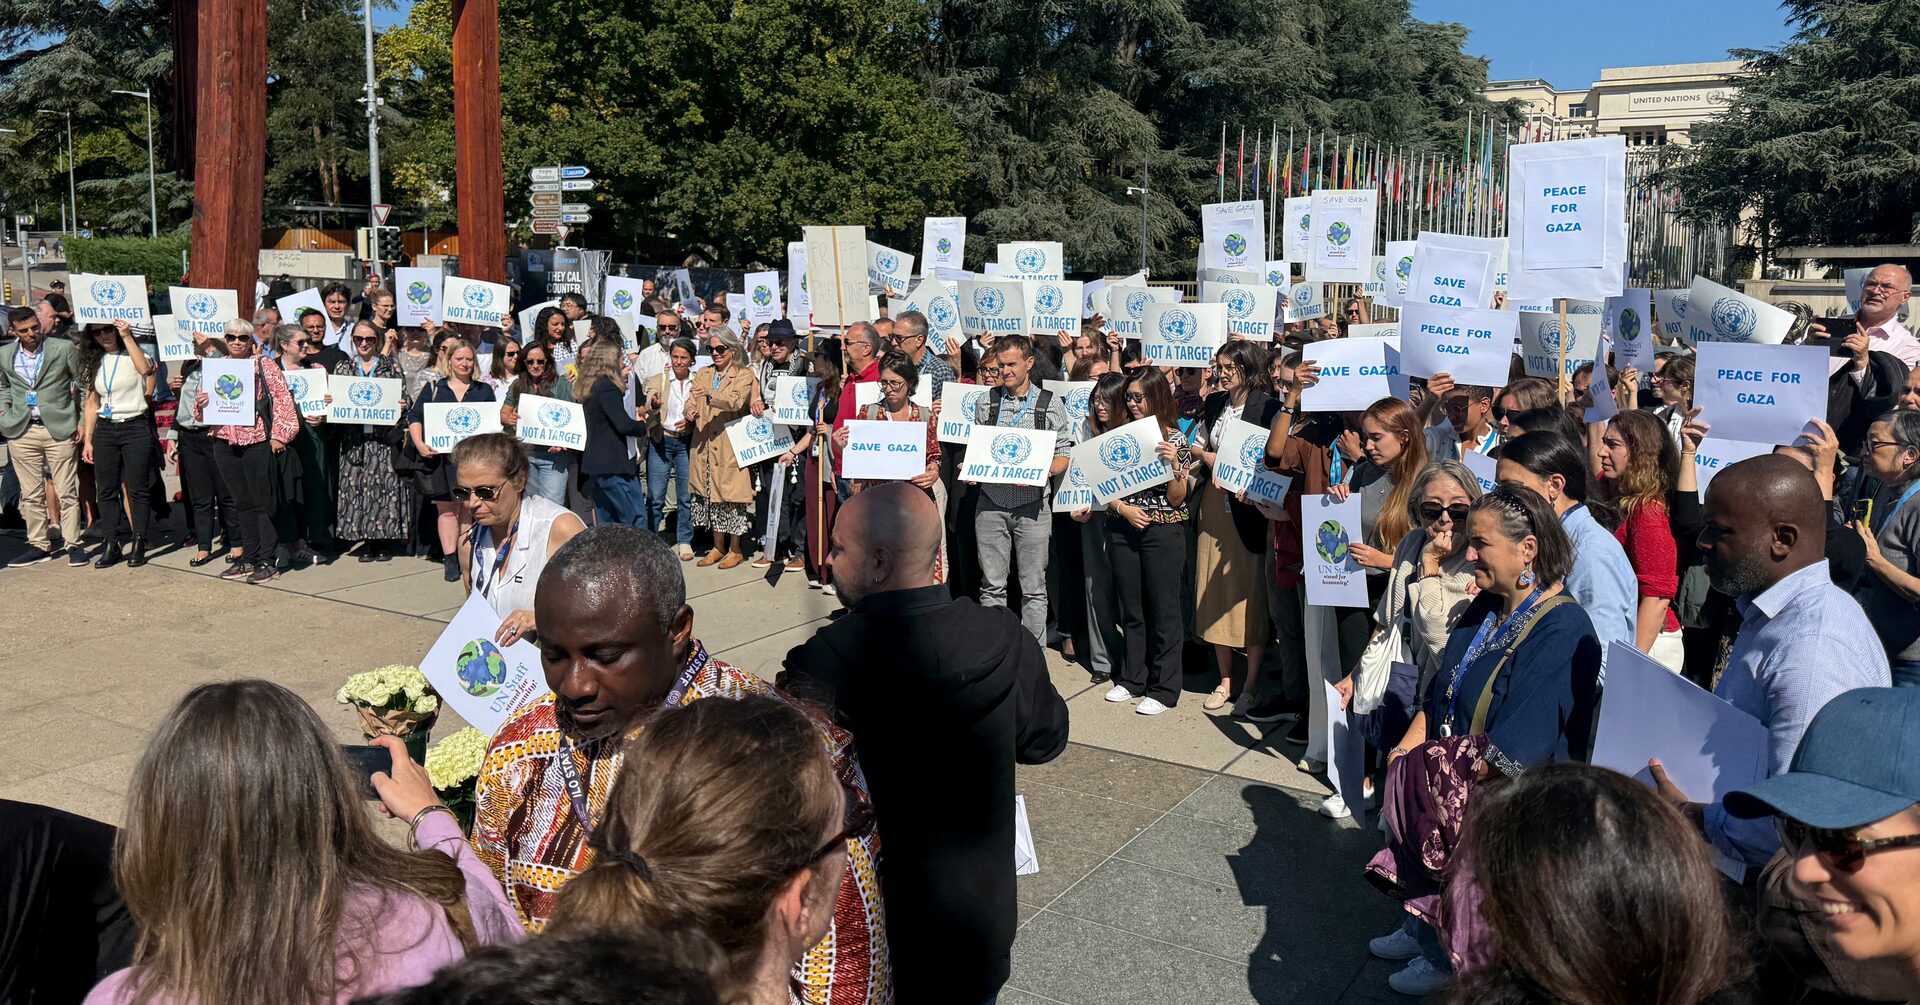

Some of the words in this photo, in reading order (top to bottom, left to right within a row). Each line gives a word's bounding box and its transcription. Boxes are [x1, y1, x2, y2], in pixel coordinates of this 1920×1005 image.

[1664, 94, 1700, 102] NATIONS
[1544, 186, 1586, 196] PEACE
[1323, 196, 1344, 204] SAVE
[1348, 196, 1368, 204] GAZA
[1216, 206, 1234, 215] SAVE
[1236, 204, 1256, 214] GAZA
[1551, 204, 1577, 213] FOR
[1546, 222, 1582, 233] GAZA
[547, 272, 566, 282] THEY
[567, 271, 581, 282] CAL
[1434, 276, 1466, 288] SAVE
[1365, 282, 1378, 292] NOT
[906, 302, 920, 312] NO
[1429, 295, 1462, 307] GAZA
[80, 307, 99, 318] NOT
[101, 309, 106, 319] A
[109, 308, 143, 320] TARGET
[448, 306, 464, 318] NOT
[466, 309, 472, 318] A
[1288, 308, 1300, 318] NOT
[1300, 307, 1305, 318] A
[1305, 304, 1321, 316] TARGET
[178, 320, 190, 332] NOT
[192, 322, 198, 332] A
[198, 322, 225, 333] TARG
[965, 316, 979, 330] NOT
[982, 318, 987, 330] A
[988, 316, 1021, 331] TARGET
[1037, 317, 1043, 330] A
[1044, 316, 1076, 331] TARGET
[1115, 320, 1130, 332] NOT
[1132, 321, 1137, 332] A
[1232, 320, 1268, 335] TARGET
[1664, 322, 1682, 333] NOT
[1421, 324, 1460, 336] PEACE
[1467, 329, 1492, 339] FOR
[1690, 326, 1712, 342] NOT
[165, 345, 183, 355] NOT
[184, 344, 190, 354] A
[1145, 345, 1164, 359] NOT
[1166, 346, 1172, 360] A
[1174, 346, 1214, 361] TARGET
[1436, 344, 1470, 355] GAZA
[1528, 355, 1544, 371] NOT
[1546, 359, 1552, 371] A
[1316, 366, 1350, 376] AVE
[1359, 366, 1399, 375] GAZA
[1718, 369, 1762, 381] PEACE
[1772, 372, 1801, 384] FOR
[1737, 393, 1776, 405] GAZA
[300, 400, 325, 412] RGET
[334, 407, 351, 419] NOT
[353, 408, 359, 418] A
[362, 408, 396, 420] TARGET
[778, 408, 793, 420] NOT
[795, 409, 801, 420] A
[522, 426, 538, 439] NOT
[540, 428, 546, 439] A
[548, 428, 582, 445] TARGET
[943, 422, 960, 436] NOT
[963, 424, 970, 438] A
[432, 436, 449, 448] NOT
[851, 442, 880, 451] SAVE
[888, 444, 918, 453] GAZA
[740, 448, 757, 462] NOT
[759, 445, 765, 455] A
[766, 437, 793, 454] TARGET
[1694, 455, 1719, 468] AVE
[967, 464, 990, 476] NOT
[991, 466, 999, 478] A
[1003, 466, 1044, 480] TARGET
[1097, 478, 1118, 497] NOT
[1119, 474, 1128, 488] A
[1129, 458, 1168, 485] TARGET
[1217, 462, 1232, 481] NOT
[1234, 469, 1243, 485] A
[1244, 472, 1283, 500] TARGET
[1476, 477, 1498, 493] PEA
[1058, 490, 1071, 504] NOT
[1072, 490, 1079, 504] A
[1318, 565, 1332, 574] UN
[699, 650, 708, 662] LO
[680, 659, 702, 687] STAFF
[490, 692, 508, 714] UN
[506, 662, 529, 691] Staff
[505, 688, 523, 711] stand
[519, 678, 529, 692] for
[560, 746, 576, 779] STAFF
[569, 780, 582, 798] ILO
